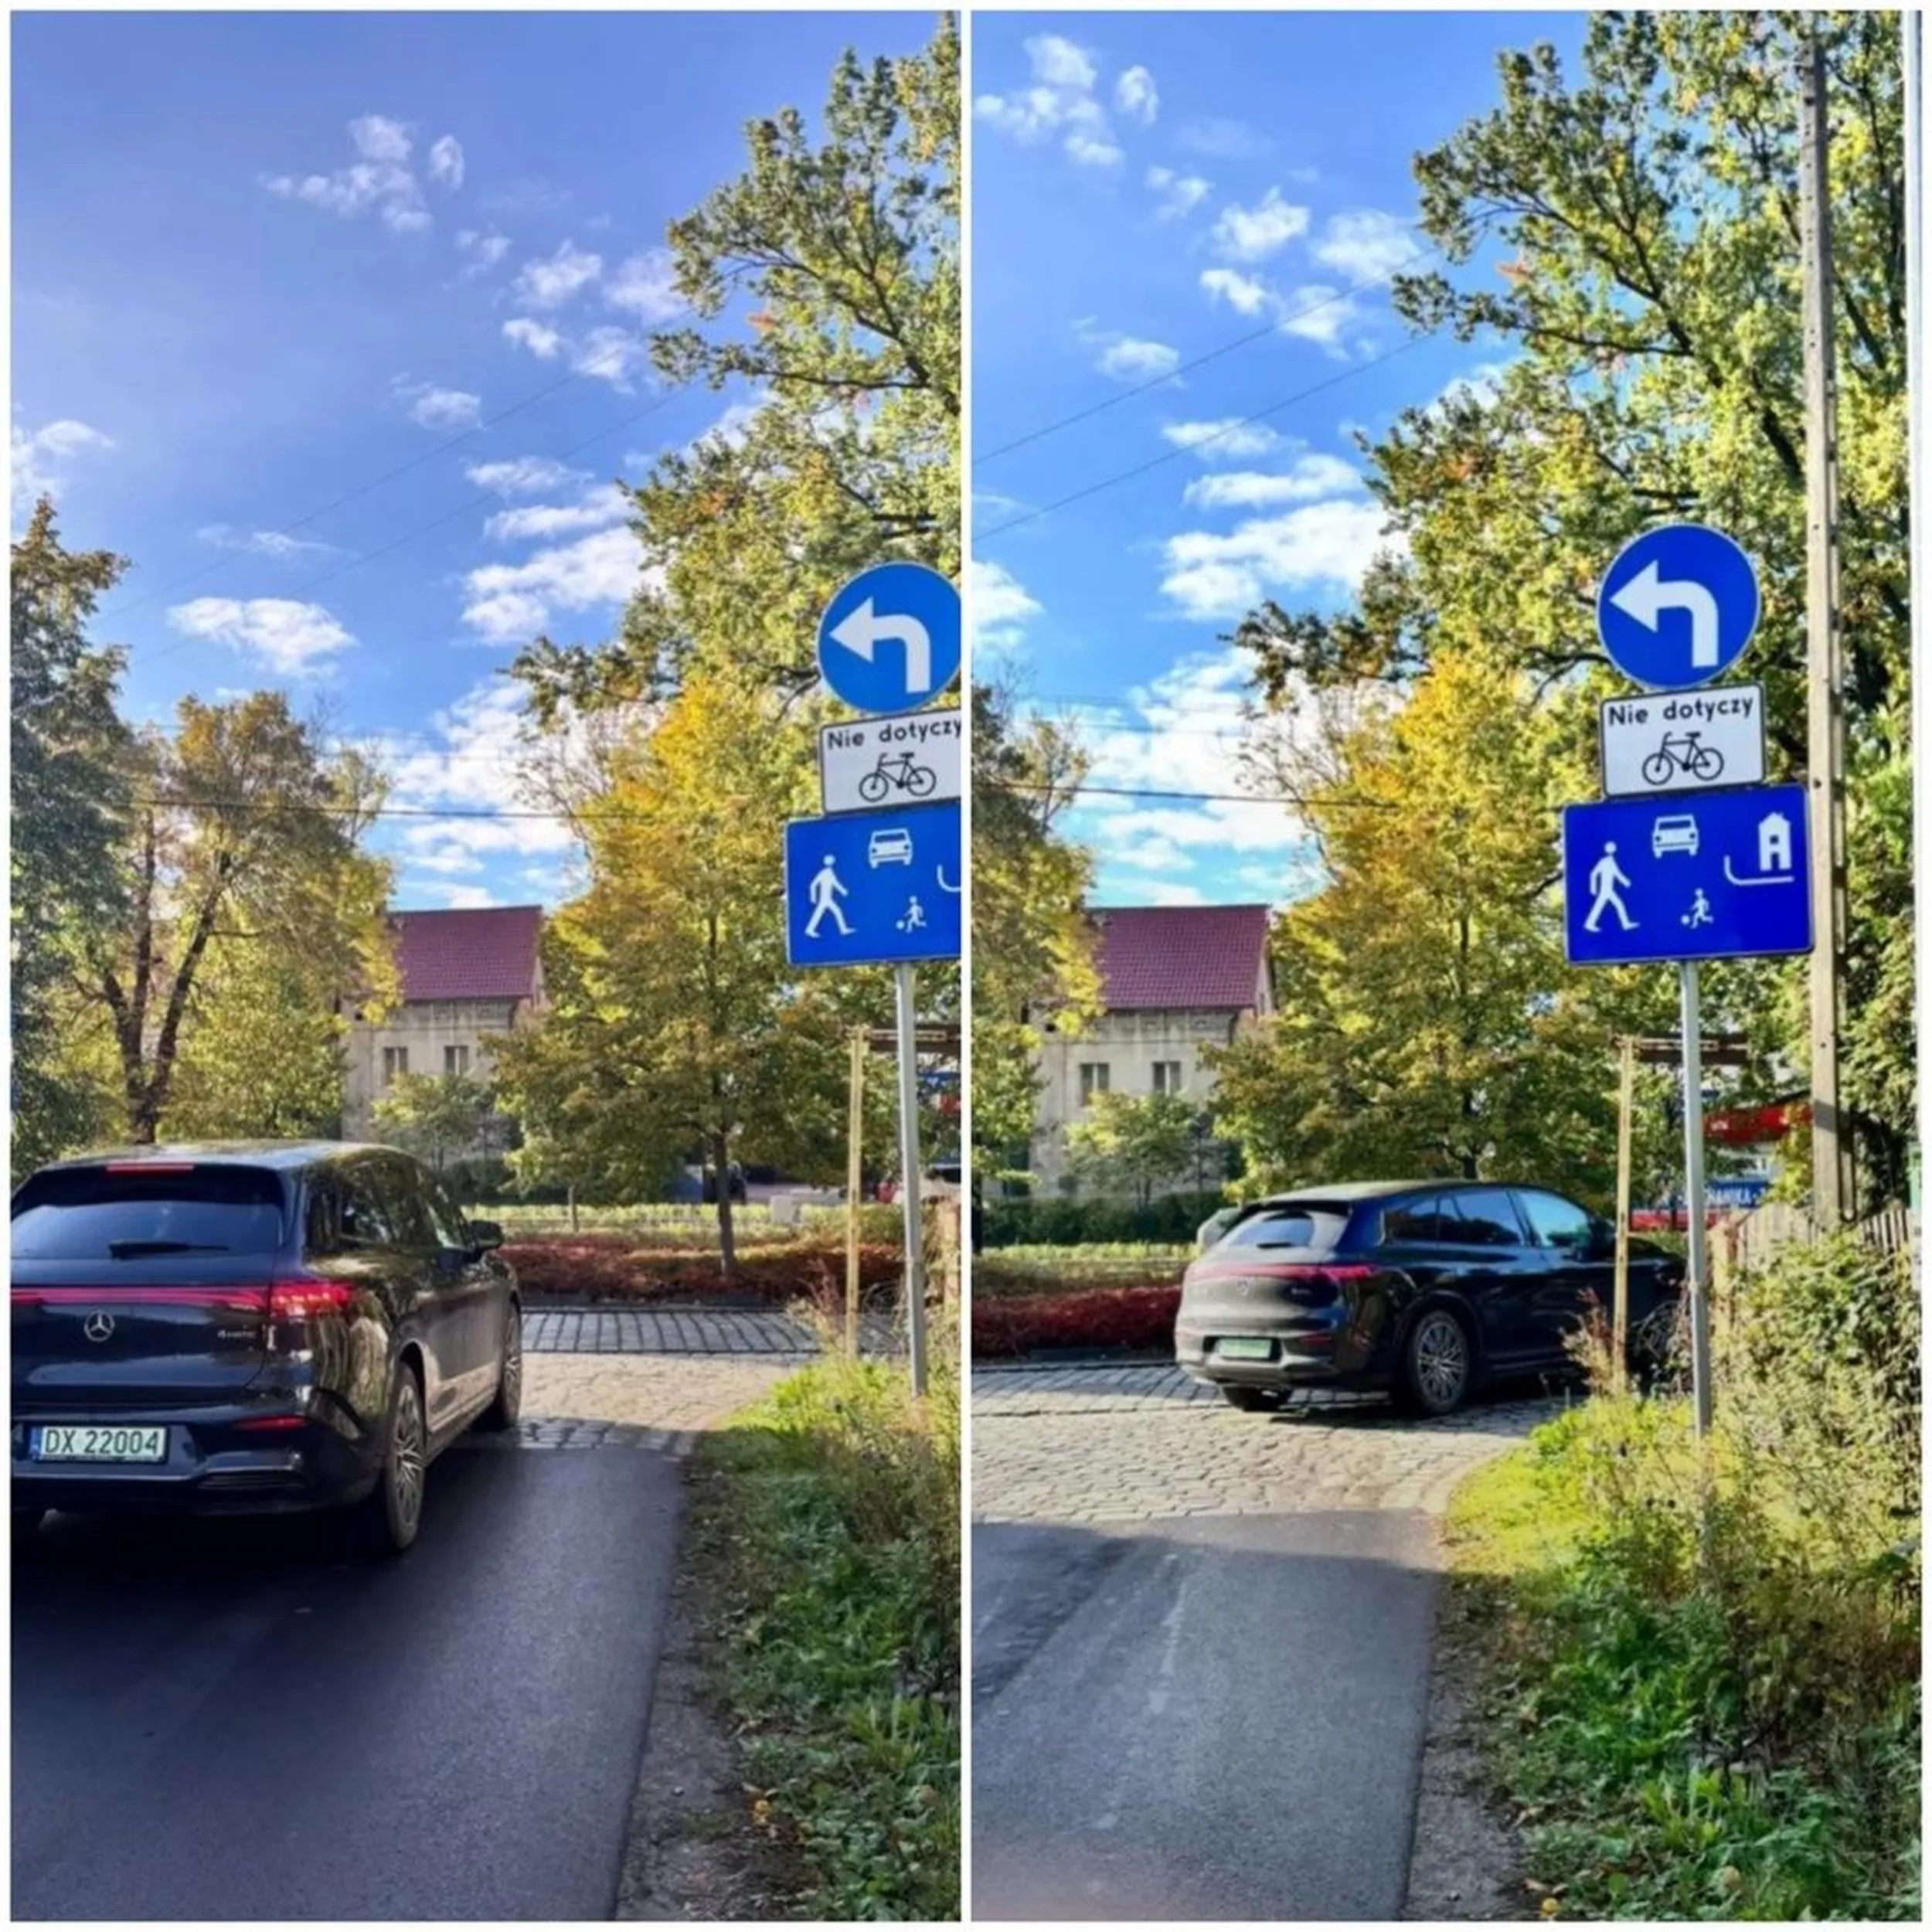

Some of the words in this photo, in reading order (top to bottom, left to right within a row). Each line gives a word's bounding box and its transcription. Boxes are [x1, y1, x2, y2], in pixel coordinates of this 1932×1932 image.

[1608, 704, 1649, 726] Nie
[1662, 697, 1753, 723] dotyczy
[828, 729, 866, 750] Nie
[45, 1429, 77, 1454] DX
[84, 1430, 160, 1455] 22004
